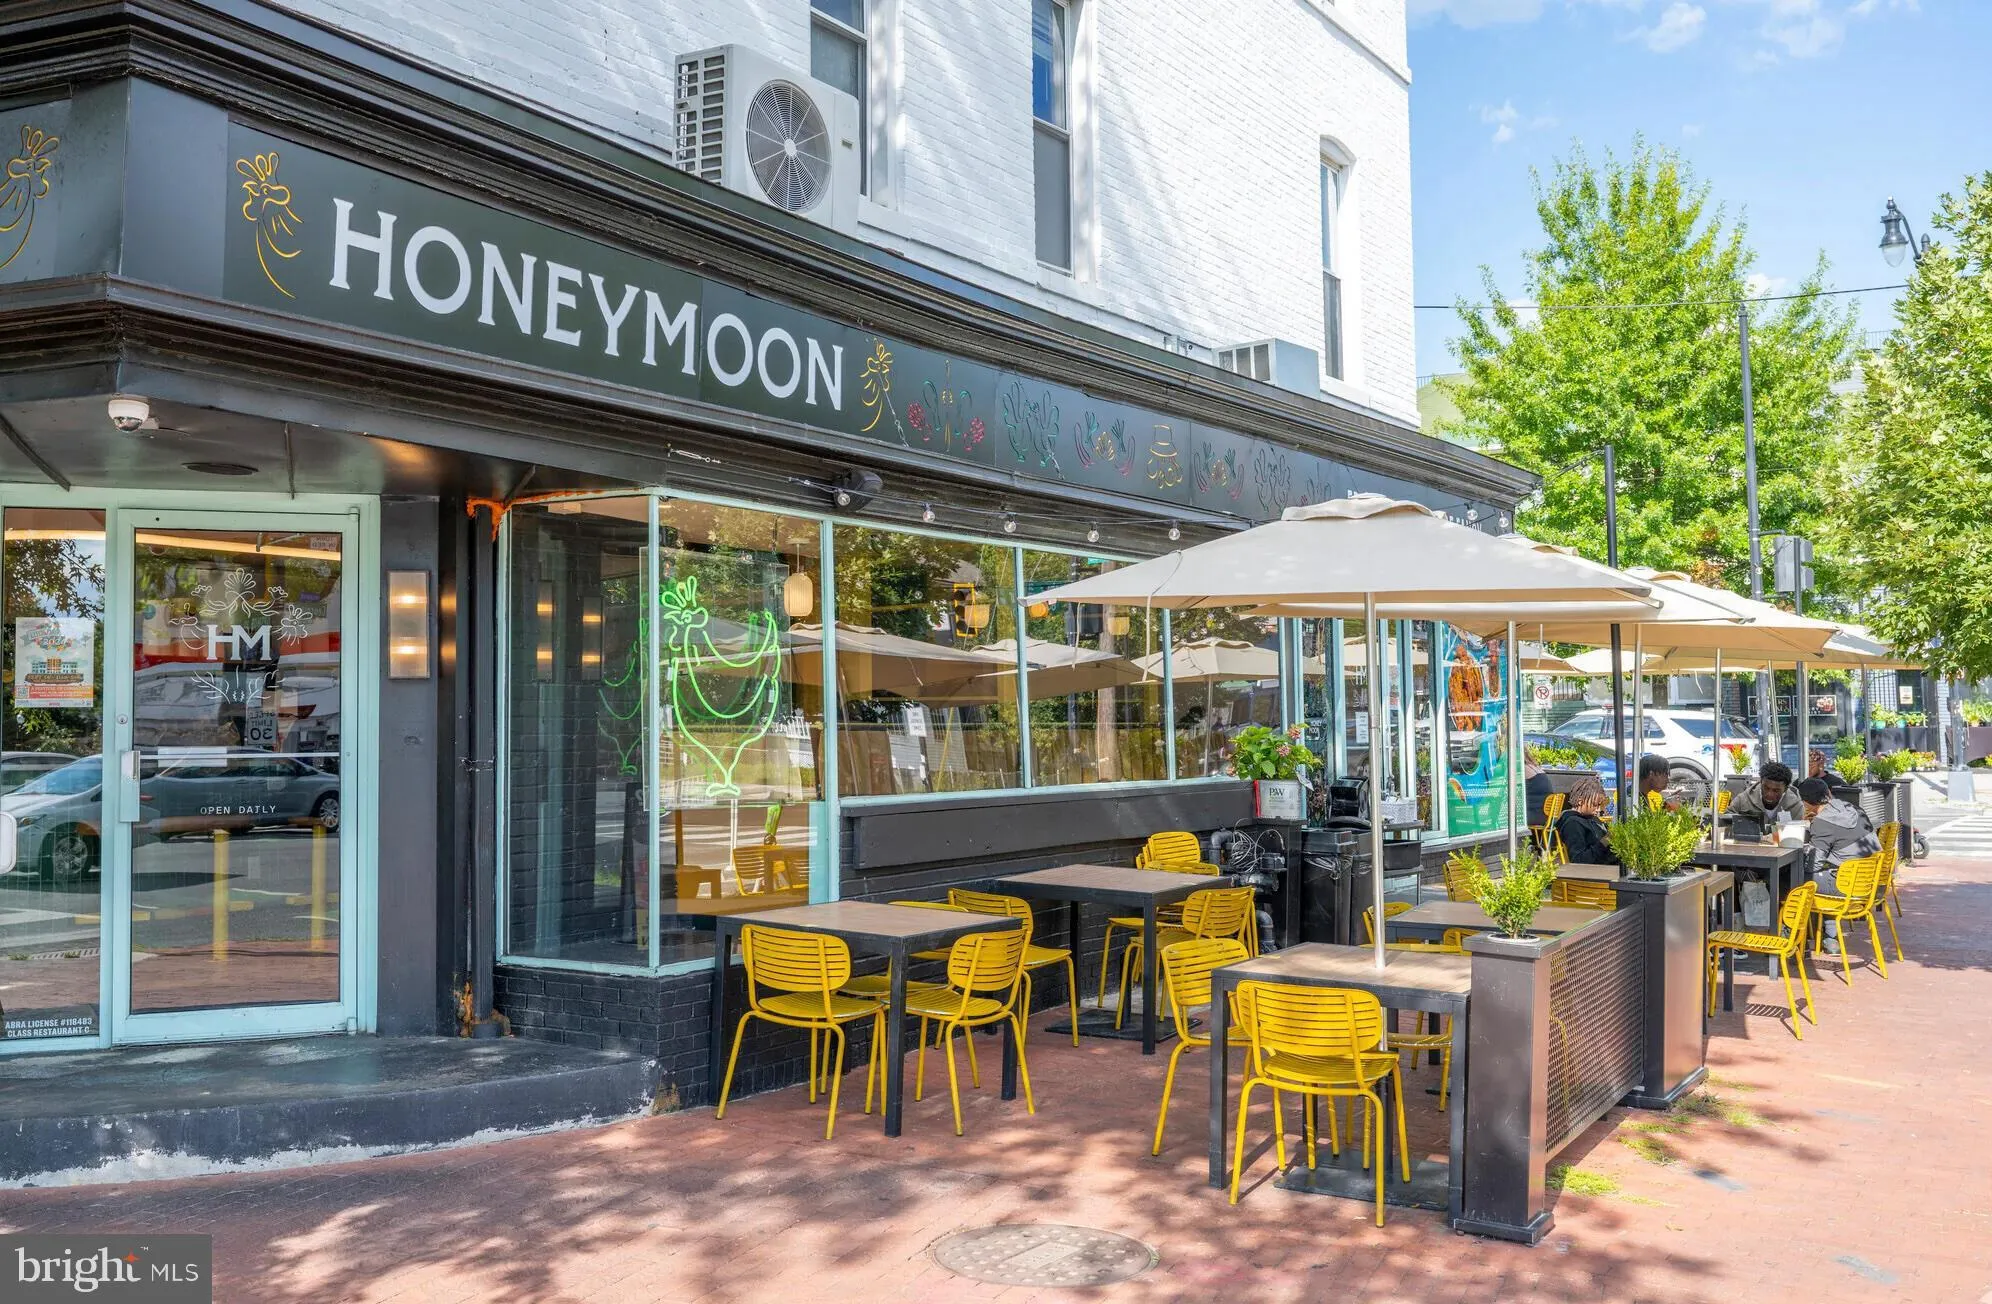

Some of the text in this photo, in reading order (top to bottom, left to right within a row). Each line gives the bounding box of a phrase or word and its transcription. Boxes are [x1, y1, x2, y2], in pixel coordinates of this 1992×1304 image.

[330, 198, 844, 411] HONEYMOON
[206, 624, 272, 660] HM
[200, 805, 276, 815] OPEN DAILY
[5, 1021, 26, 1030] ABRA
[27, 1019, 59, 1028] LICENSE
[7, 1029, 32, 1038] CLASS
[33, 1027, 82, 1036] RESTAURANT
